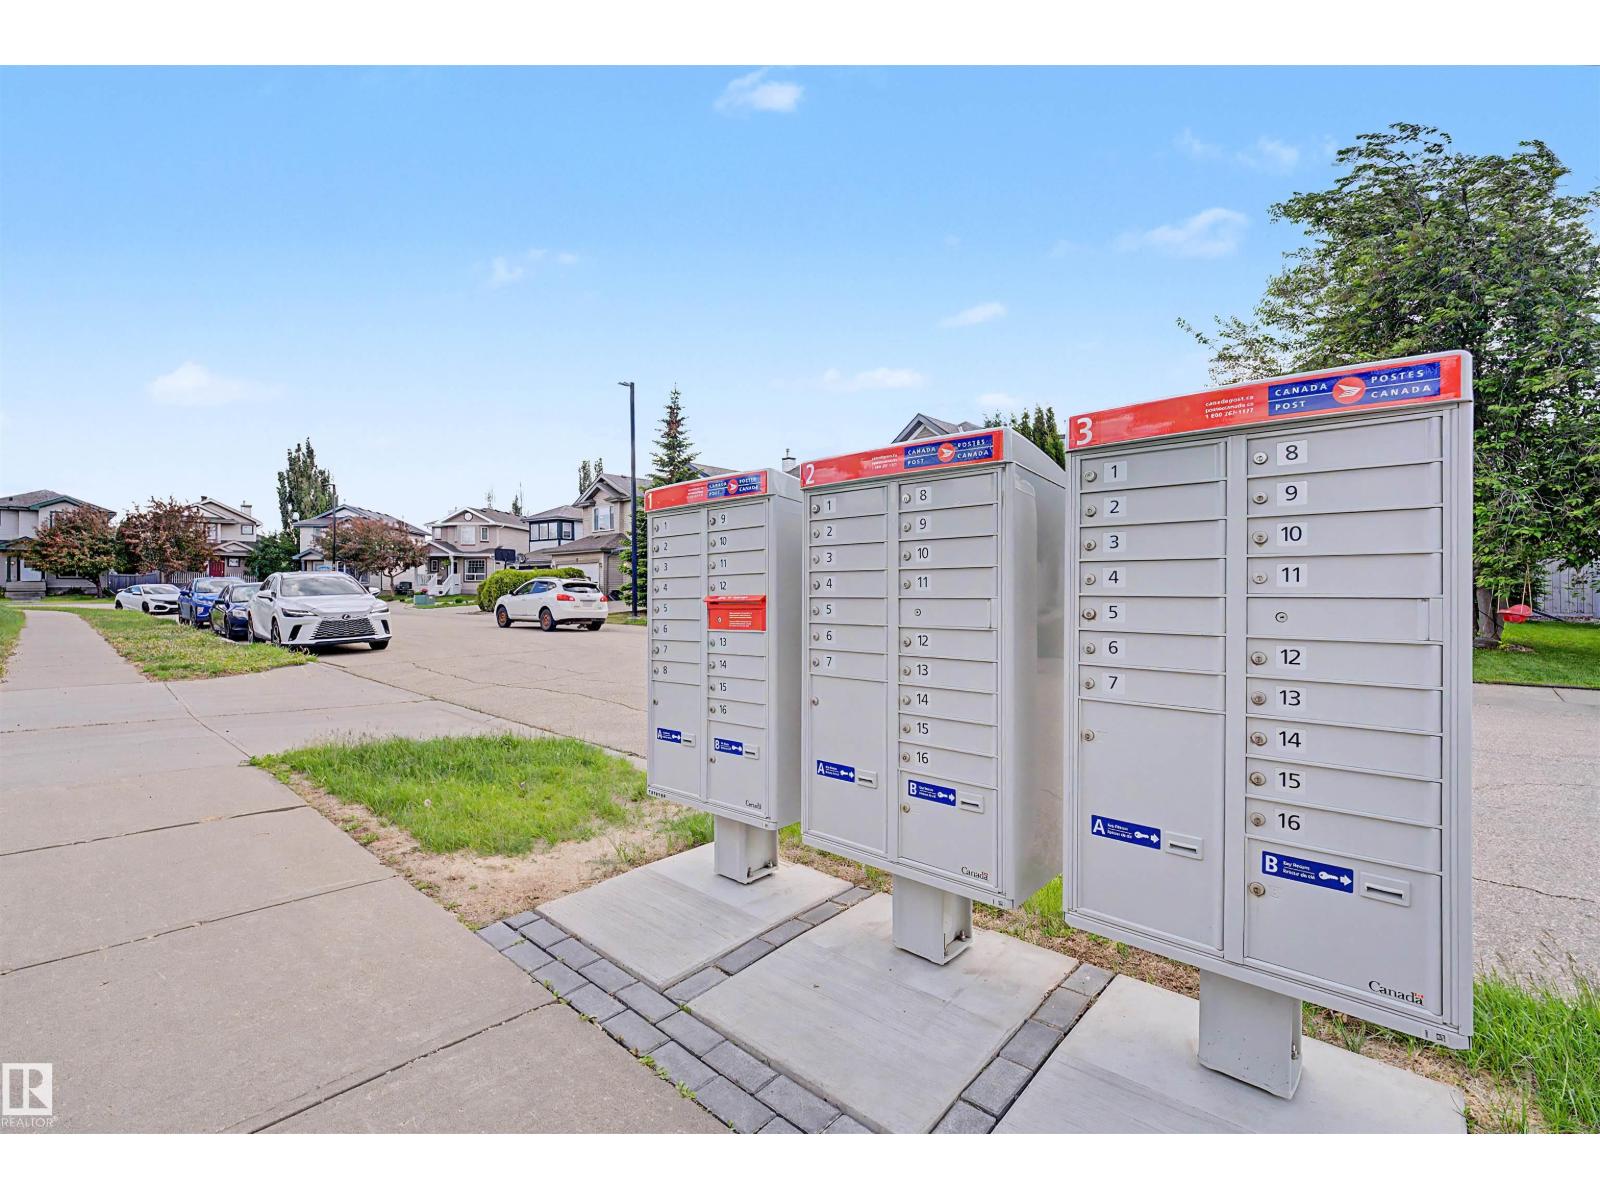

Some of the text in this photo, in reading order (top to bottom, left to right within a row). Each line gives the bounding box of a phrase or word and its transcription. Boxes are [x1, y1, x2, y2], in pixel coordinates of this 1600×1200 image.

[1370, 369, 1424, 383] POSTES
[1274, 382, 1328, 397] CANADA
[1370, 384, 1431, 398] CANADA
[1274, 400, 1306, 411] POST
[1076, 417, 1093, 446] 3
[957, 439, 985, 448] POSTES
[907, 446, 936, 456] CANADA
[957, 449, 989, 459] CANADA
[1286, 445, 1299, 460] 8
[907, 458, 925, 466] POST
[805, 463, 815, 485] 2
[1112, 465, 1117, 478] 1
[919, 489, 927, 500] 8
[1286, 486, 1298, 501] 9
[647, 492, 652, 509] 1
[827, 500, 831, 510] 1
[1110, 501, 1120, 513] 2
[720, 514, 726, 524] 9
[919, 518, 927, 529] 9
[664, 522, 668, 530] 1
[826, 526, 833, 536] 2
[1282, 526, 1303, 541] 10
[663, 542, 668, 551] 2
[719, 537, 727, 546] 10
[1110, 535, 1119, 548] 3
[826, 552, 833, 562] 3
[917, 547, 929, 558] 10
[663, 563, 668, 571] 3
[720, 560, 727, 568] 11
[1109, 571, 1119, 583] 4
[1282, 567, 1300, 582] 11
[719, 581, 727, 591] 12
[826, 577, 833, 588] 4
[917, 576, 928, 587] 11
[663, 584, 668, 592] 4
[663, 604, 668, 613] 5
[826, 604, 832, 614] 5
[1109, 606, 1118, 618] 5
[663, 625, 668, 633] 6
[826, 630, 833, 640] 6
[917, 634, 929, 646] 12
[719, 638, 727, 647] 13
[1109, 641, 1119, 654] 6
[663, 645, 668, 653] 7
[826, 656, 832, 666] 7
[1281, 649, 1301, 665] 12
[662, 666, 668, 675] 8
[719, 661, 727, 669] 14
[916, 663, 929, 675] 13
[719, 683, 727, 692] 15
[1109, 676, 1118, 689] 7
[916, 693, 929, 705] 14
[1280, 690, 1301, 706] 13
[719, 705, 727, 715] 16
[916, 722, 929, 734] 15
[657, 729, 663, 739] A
[1280, 731, 1302, 747] 14
[714, 739, 720, 750] B
[916, 751, 929, 763] 16
[817, 762, 825, 774] A
[1279, 772, 1301, 788] 15
[909, 777, 917, 796] B
[1092, 818, 1106, 835] A
[1279, 813, 1301, 830] 16
[1265, 854, 1278, 873] B
[961, 866, 988, 881] Canada
[1368, 980, 1424, 1006] Canada
